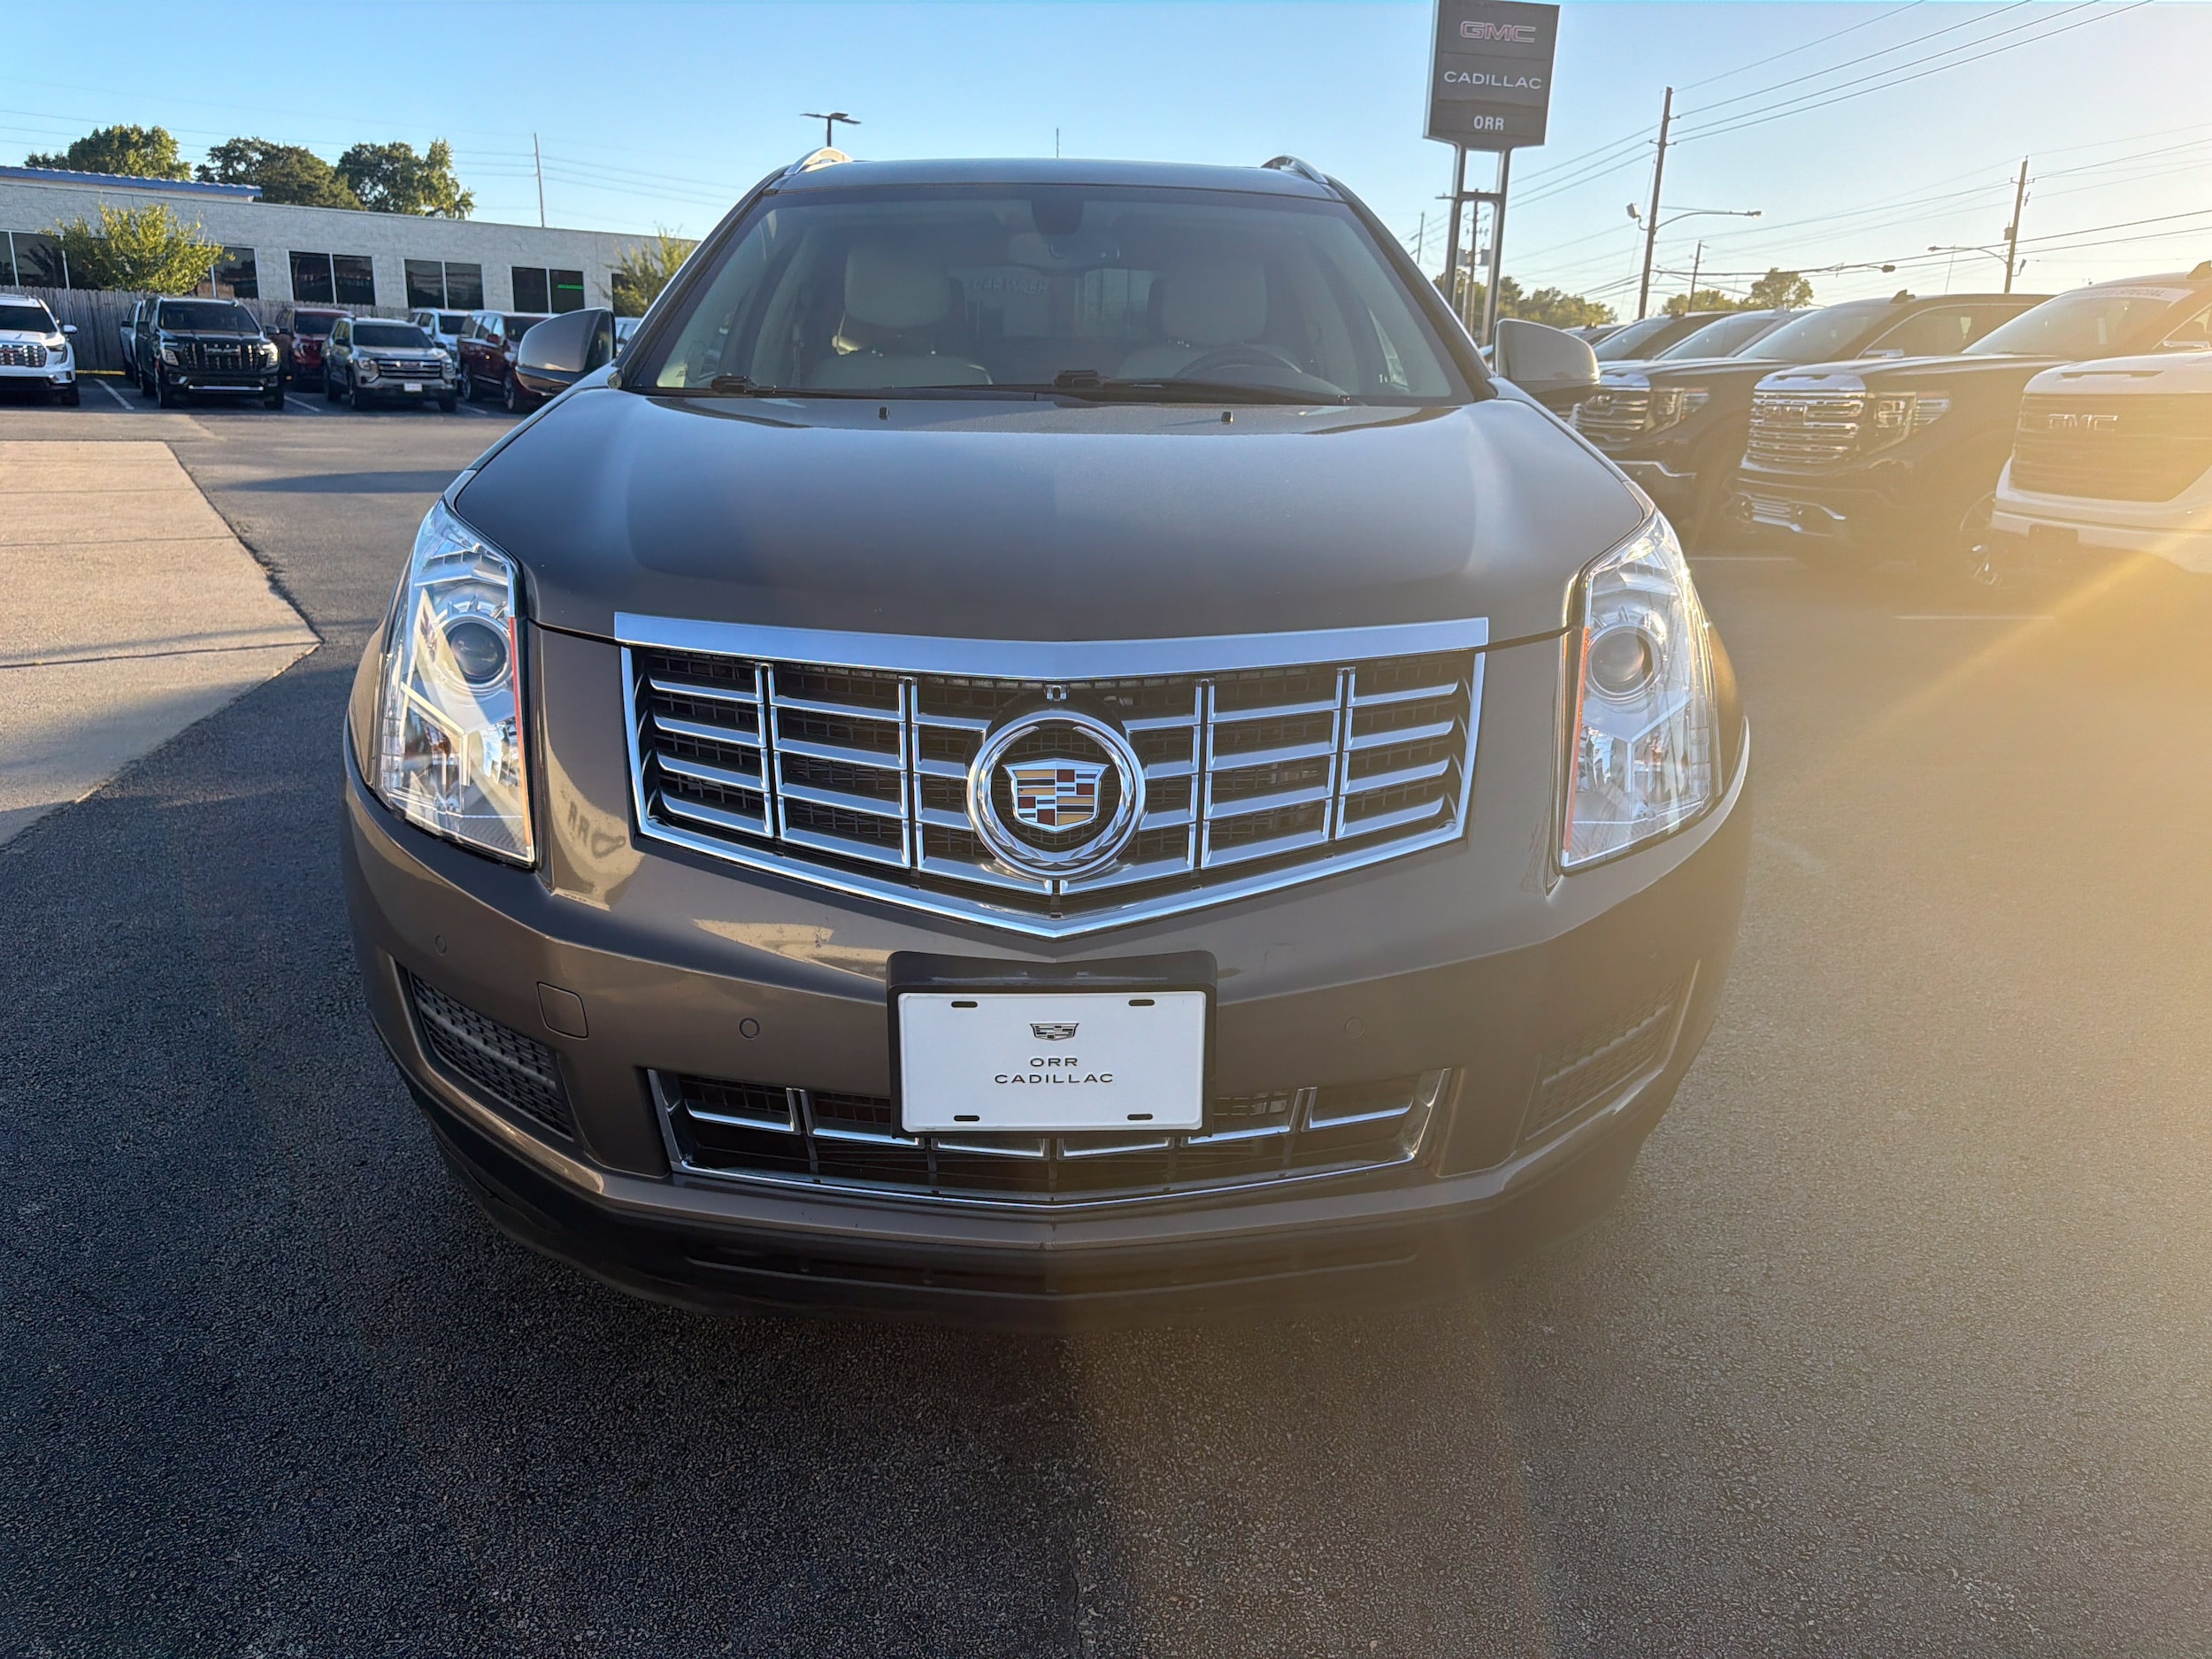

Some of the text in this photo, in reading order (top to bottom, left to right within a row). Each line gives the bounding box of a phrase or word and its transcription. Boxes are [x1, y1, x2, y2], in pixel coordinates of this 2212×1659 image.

[1461, 20, 1536, 43] GMC
[1444, 71, 1542, 89] CADILLAC
[1473, 115, 1504, 131] ORR
[2047, 413, 2118, 432] GMC
[1030, 1057, 1078, 1067] ORR
[995, 1072, 1114, 1084] CADILLAC
